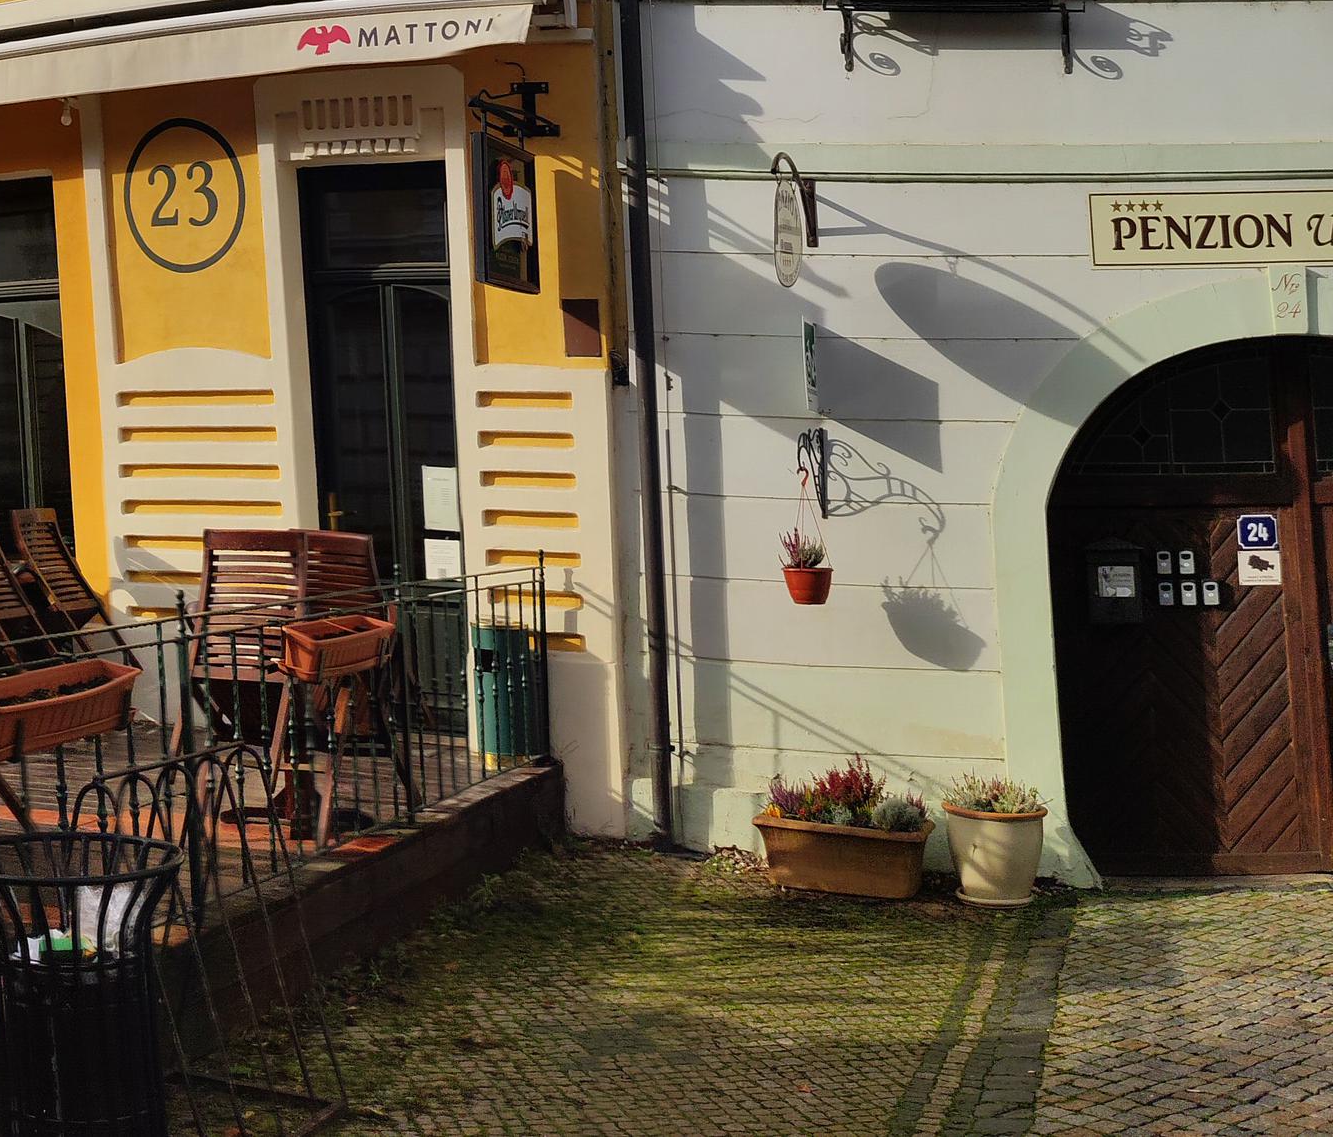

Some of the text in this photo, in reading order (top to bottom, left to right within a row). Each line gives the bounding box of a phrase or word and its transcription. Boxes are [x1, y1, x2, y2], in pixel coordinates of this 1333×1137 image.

[357, 17, 494, 48] MATTONI
[147, 160, 219, 228] 23
[1110, 213, 1293, 251] PENZION
[1276, 300, 1302, 319] 24
[1247, 522, 1270, 542] 24
